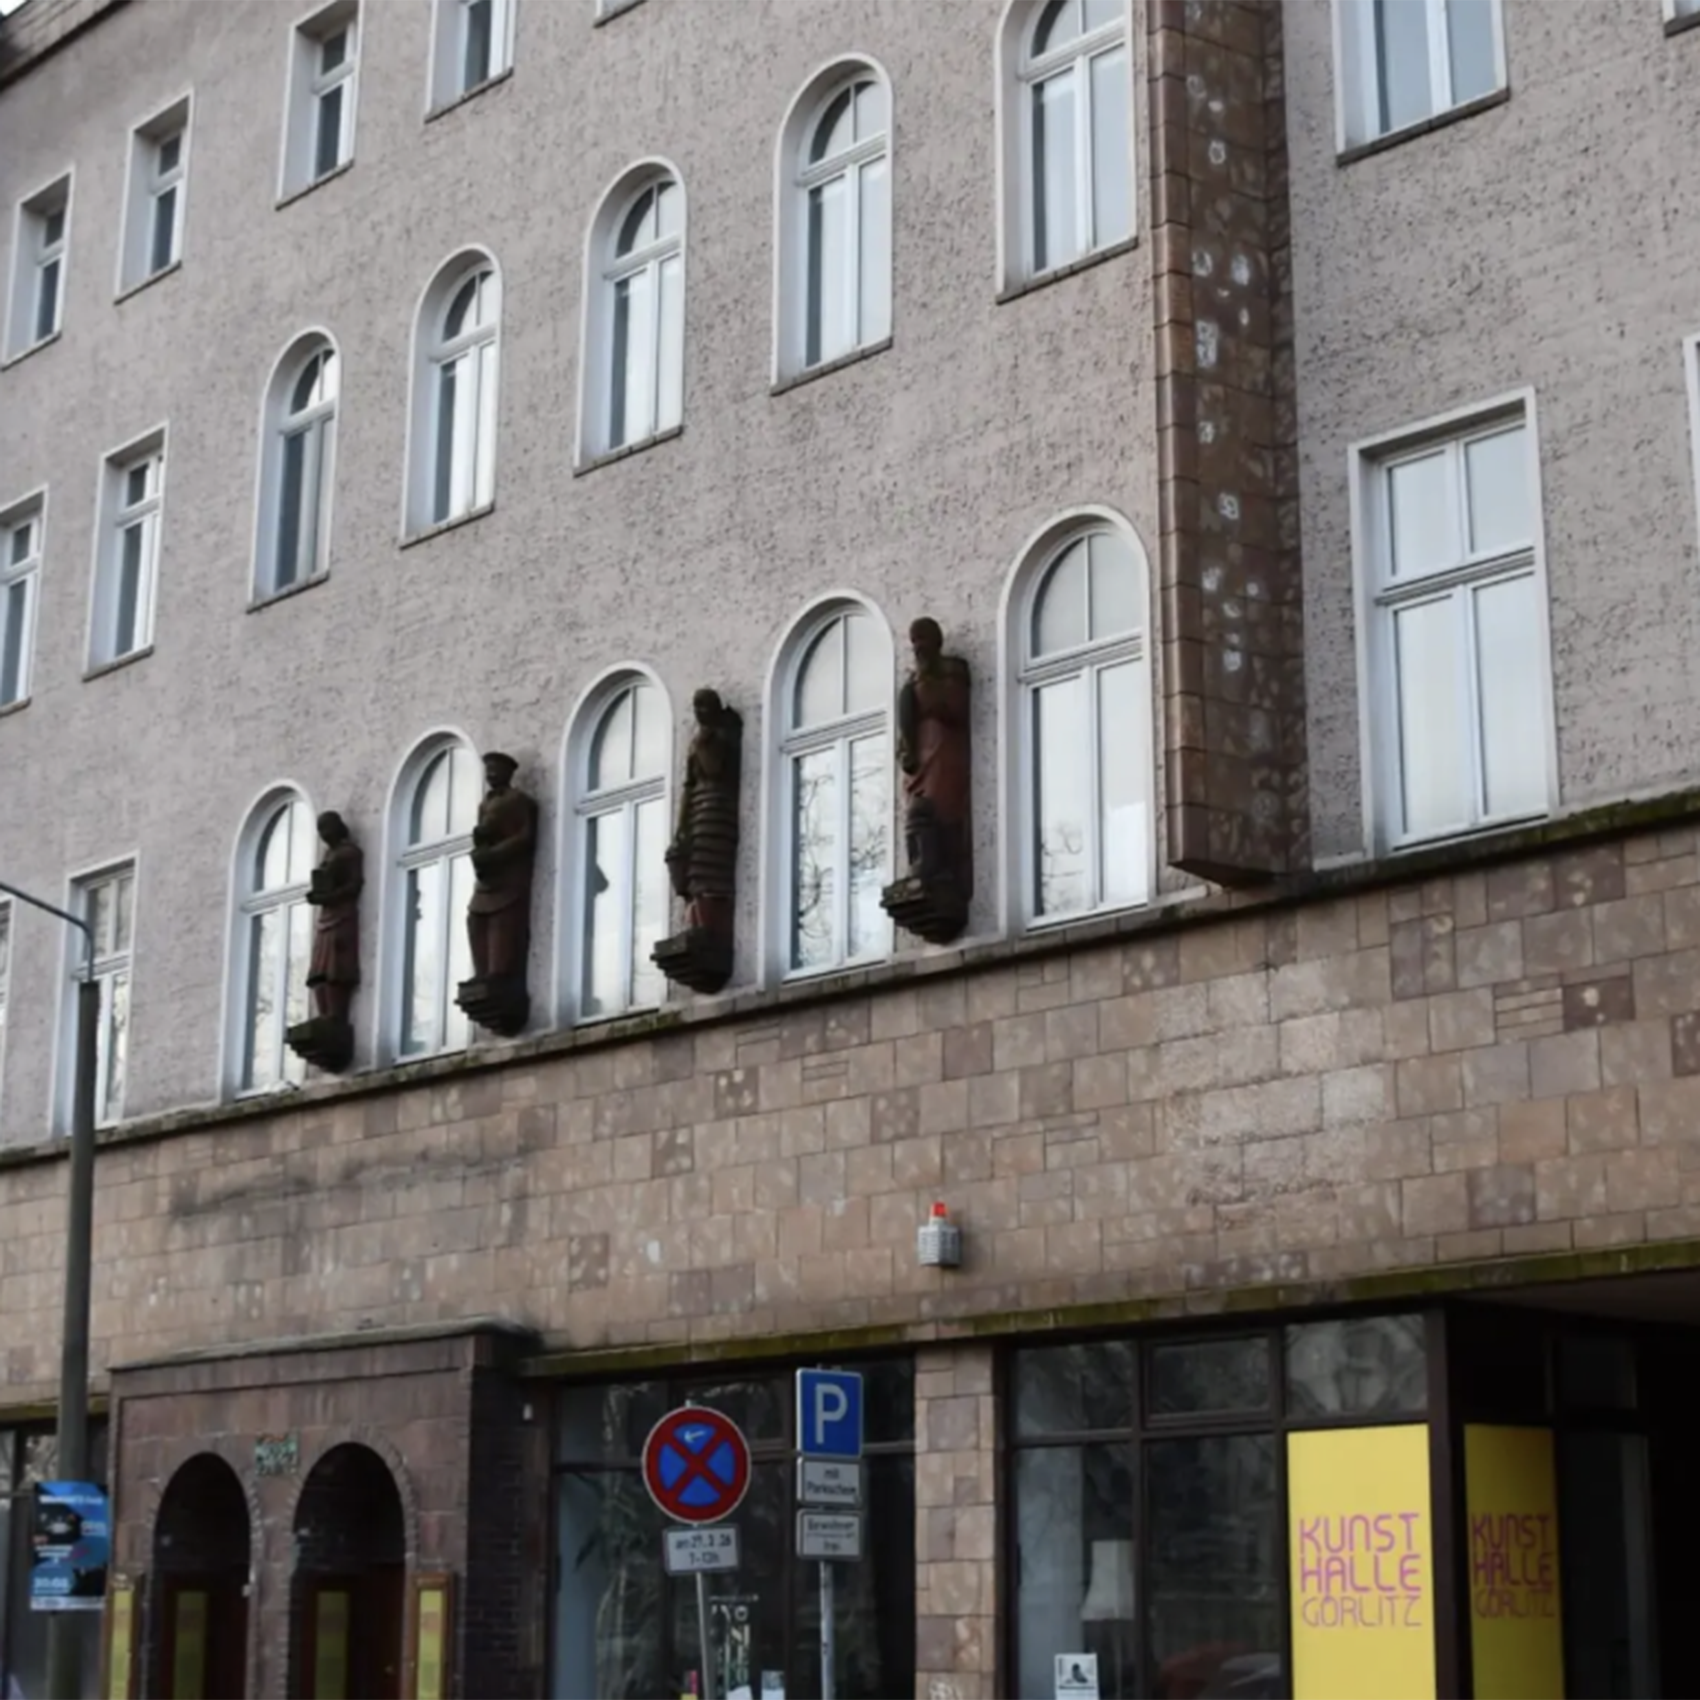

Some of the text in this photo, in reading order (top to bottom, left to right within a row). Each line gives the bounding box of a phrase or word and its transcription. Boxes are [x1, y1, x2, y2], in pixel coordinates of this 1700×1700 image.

[814, 1383, 848, 1445] P
[1299, 1512, 1420, 1554] KUNST
[1471, 1512, 1551, 1549] KUNST
[1300, 1553, 1421, 1594] HALLE
[1473, 1546, 1554, 1588] HALLE
